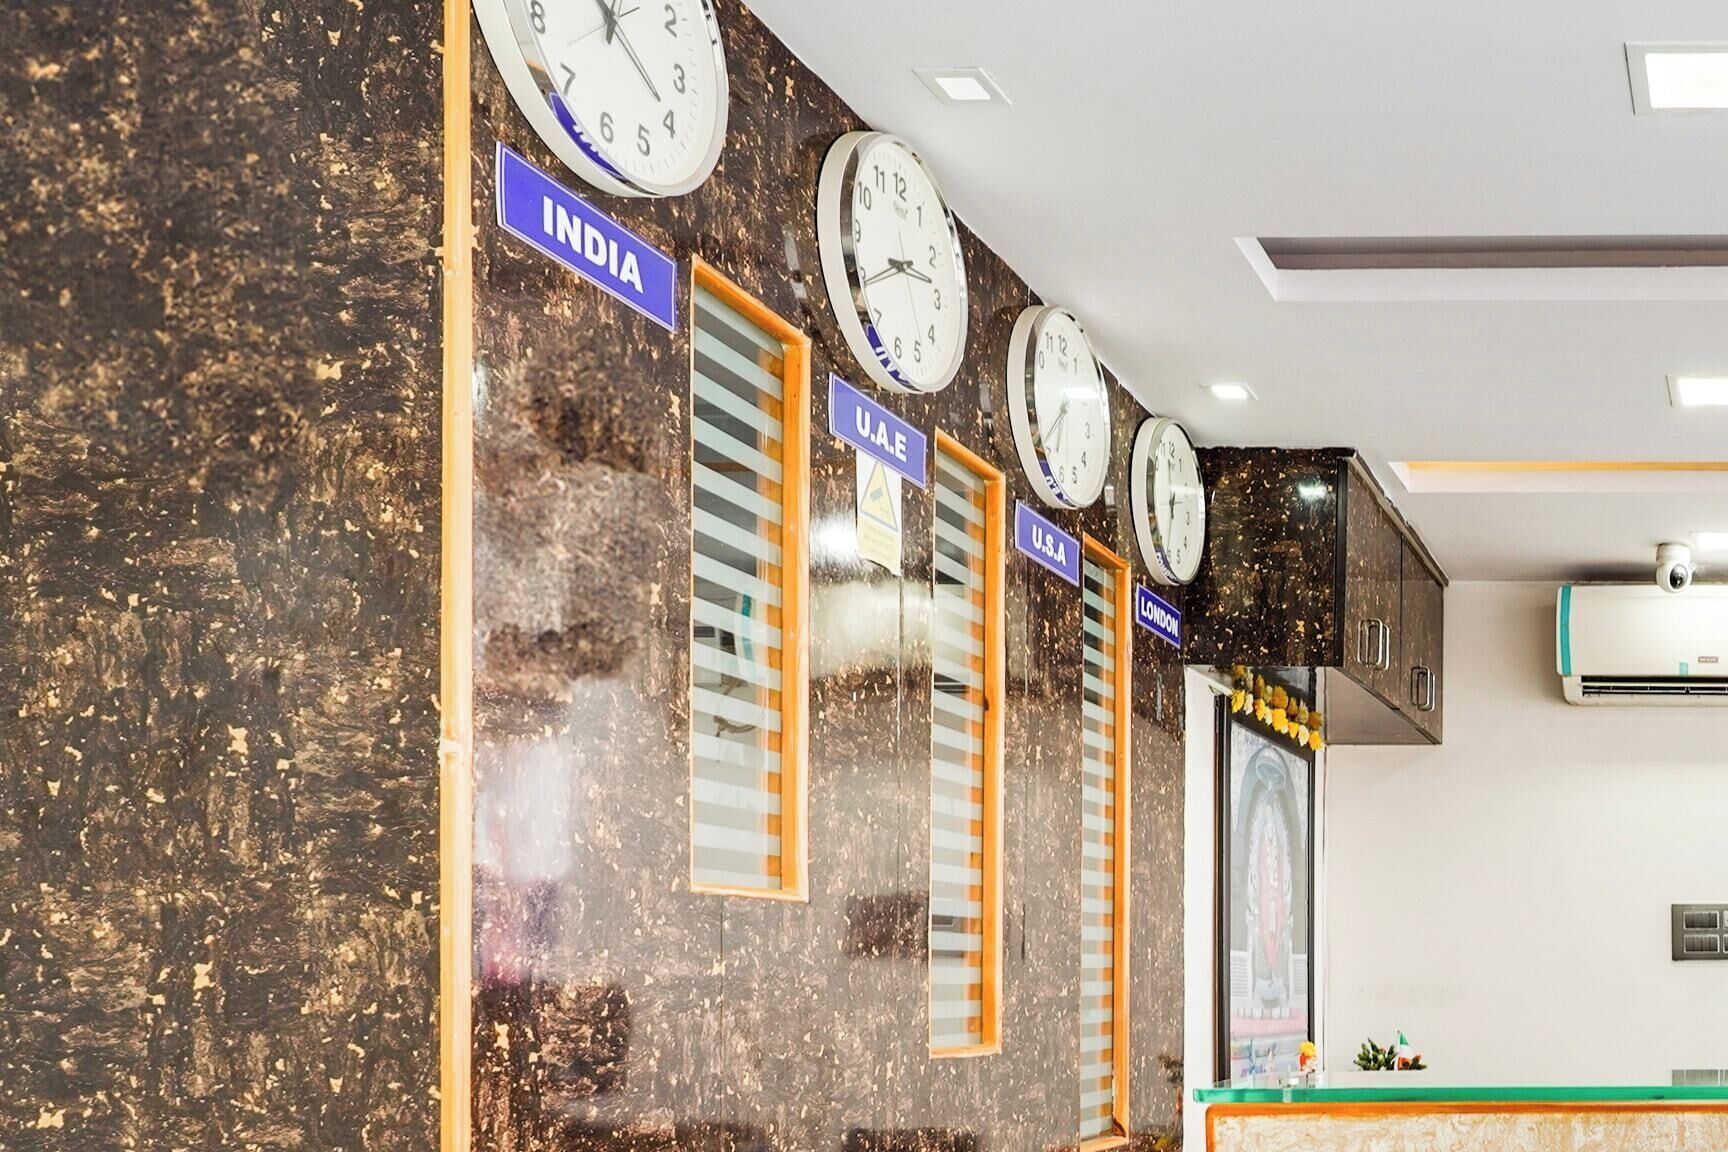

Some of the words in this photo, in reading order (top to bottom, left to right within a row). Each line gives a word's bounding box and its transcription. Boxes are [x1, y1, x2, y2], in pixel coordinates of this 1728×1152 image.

[530, 0, 546, 34] 8
[664, 4, 678, 37] 2
[560, 62, 576, 96] 7
[673, 63, 686, 94] 3
[600, 112, 614, 144] 6
[637, 123, 650, 156] 5
[663, 110, 676, 140] 4
[873, 164, 885, 194] 11
[893, 172, 907, 202] 12
[858, 181, 872, 211] 10
[916, 205, 922, 228] 1
[543, 195, 644, 294] INDIA
[929, 244, 937, 269] 2
[934, 288, 941, 311] 3
[873, 307, 882, 327] 7
[894, 336, 902, 360] 6
[927, 324, 935, 346] 4
[1058, 334, 1068, 357] 12
[914, 340, 921, 363] 5
[856, 405, 907, 463] U.A.E
[1032, 524, 1067, 567] U.S.A
[1141, 596, 1179, 638] LONDON
